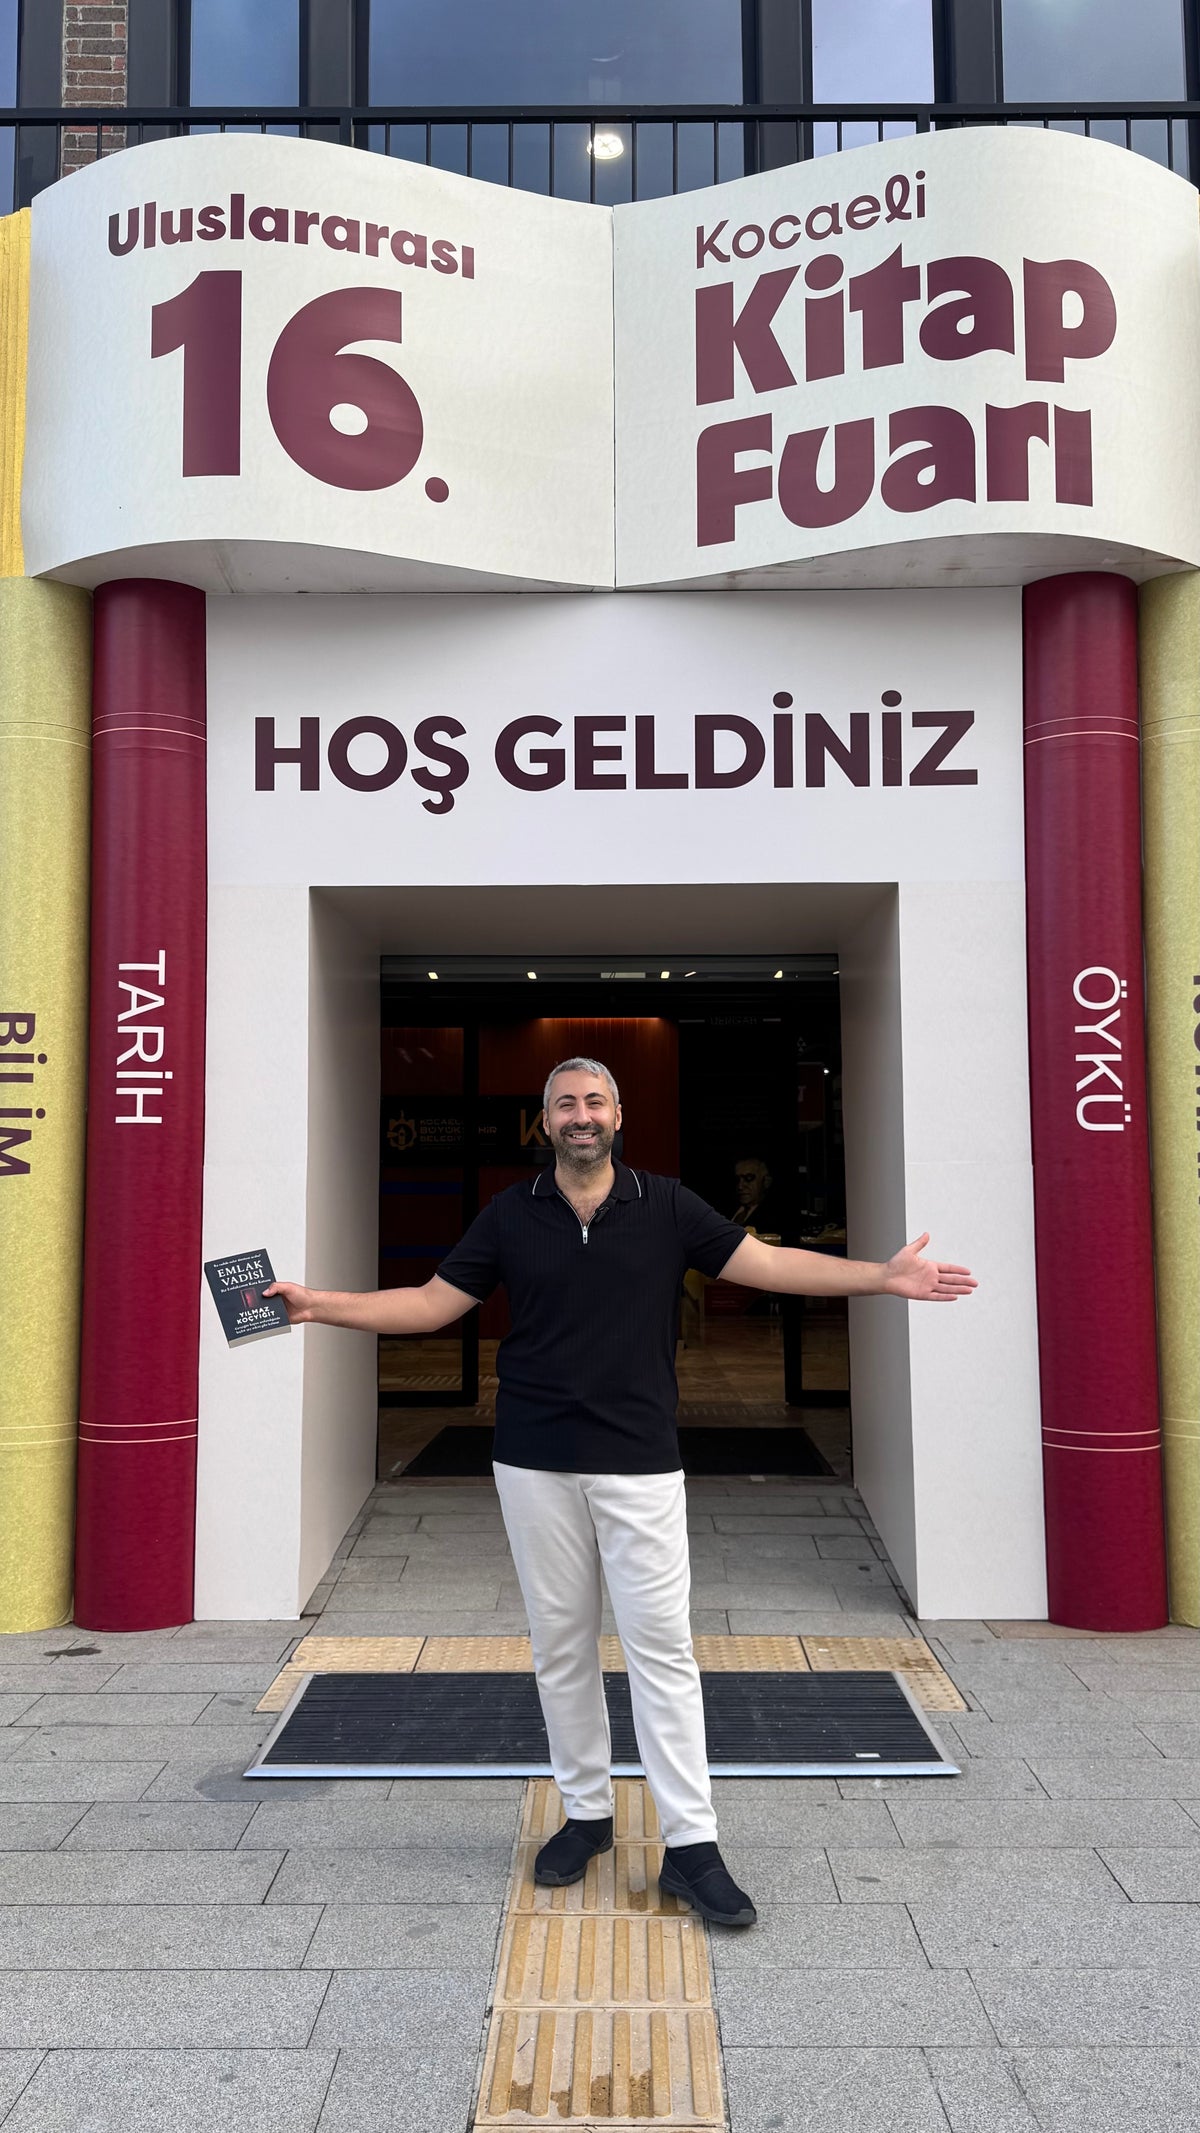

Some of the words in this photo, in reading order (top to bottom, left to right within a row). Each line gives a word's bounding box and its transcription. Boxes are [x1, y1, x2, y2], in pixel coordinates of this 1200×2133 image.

[107, 193, 476, 280] Uluslararası
[695, 169, 927, 270] Kocaeli
[150, 269, 450, 503] 16.
[694, 242, 1118, 407] Kitap
[695, 400, 1094, 548] Fuarı
[254, 714, 470, 815] HOŞ
[494, 689, 979, 791] GELDİNİZ
[0, 1012, 48, 1178] BİLİM
[115, 949, 173, 1124] TARİH
[1072, 965, 1132, 1132] ÖYKÜ
[217, 1260, 263, 1278] EMLAK
[221, 1268, 264, 1286] VADİSİ
[239, 1306, 270, 1318] YILMAZ
